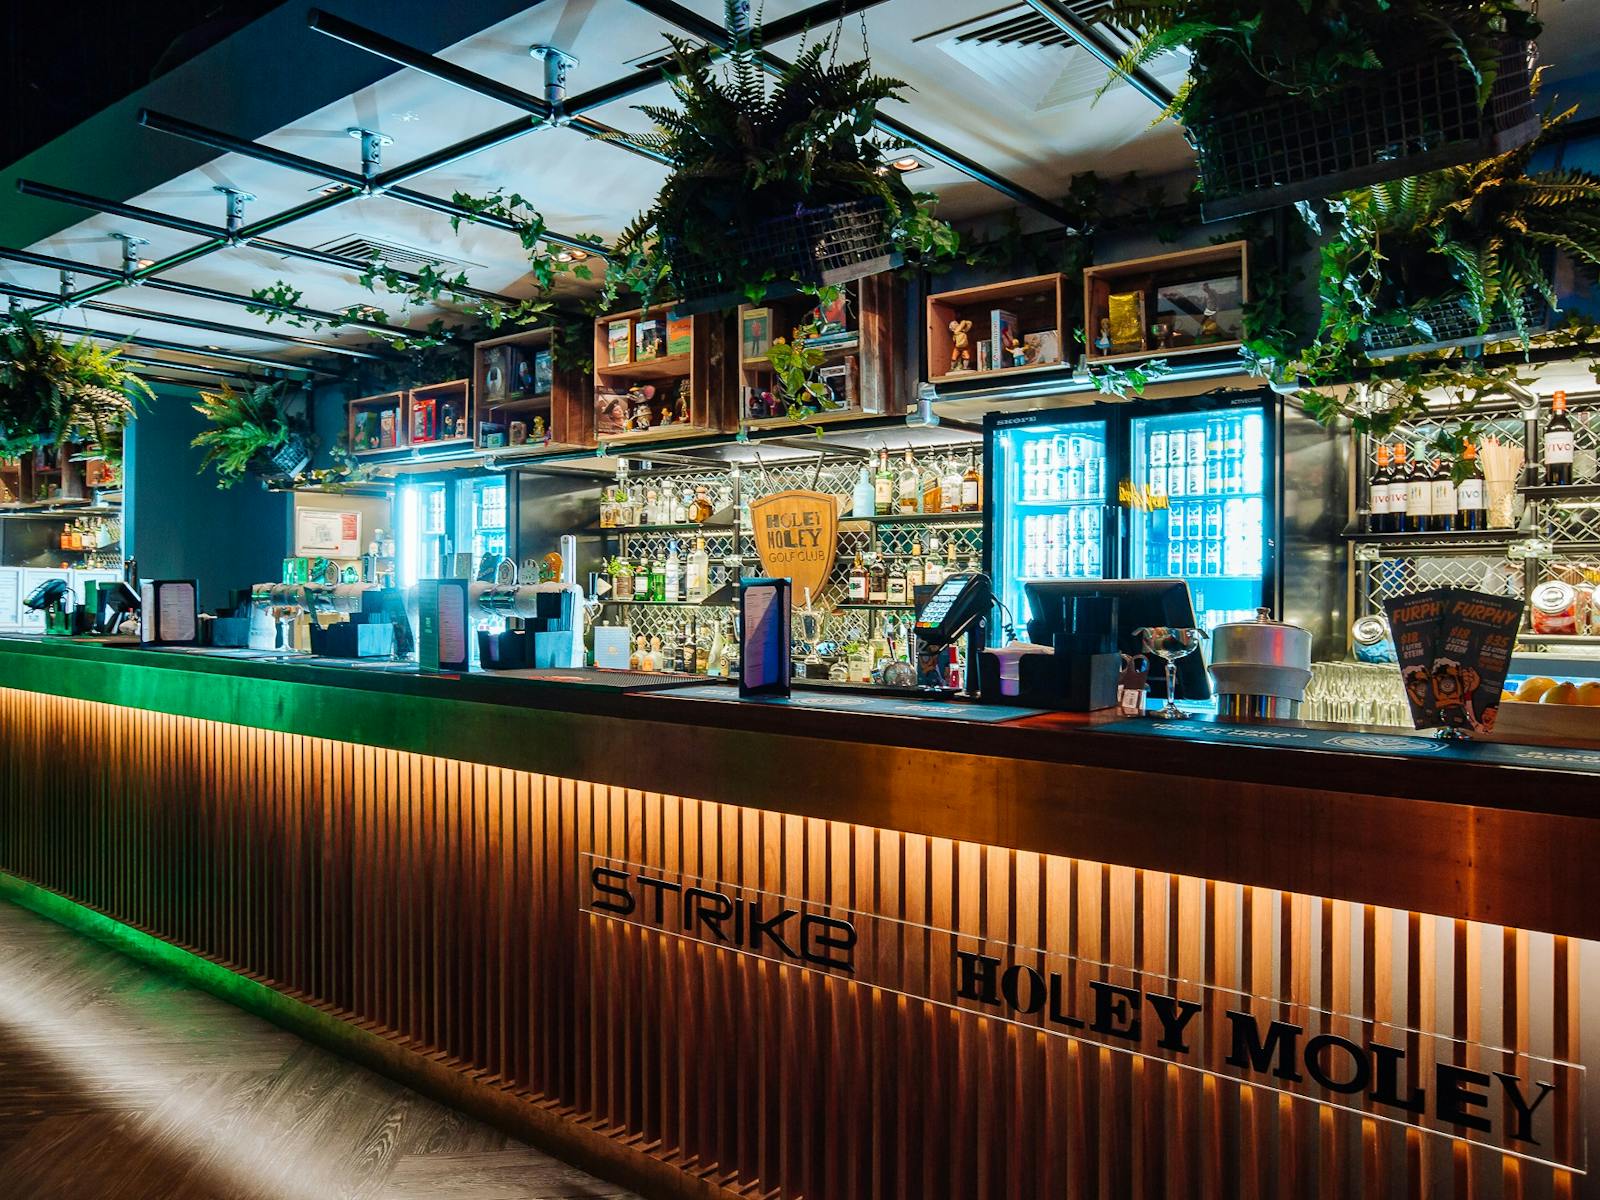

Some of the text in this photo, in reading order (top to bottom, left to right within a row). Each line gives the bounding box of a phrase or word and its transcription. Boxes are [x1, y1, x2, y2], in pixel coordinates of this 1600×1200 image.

[766, 511, 822, 528] HOLEY
[769, 550, 825, 563] GOLF CLUB
[1452, 600, 1518, 625] FURPHY
[591, 866, 857, 973] STRIKE
[955, 949, 1556, 1147] HOLEY MOLEY
